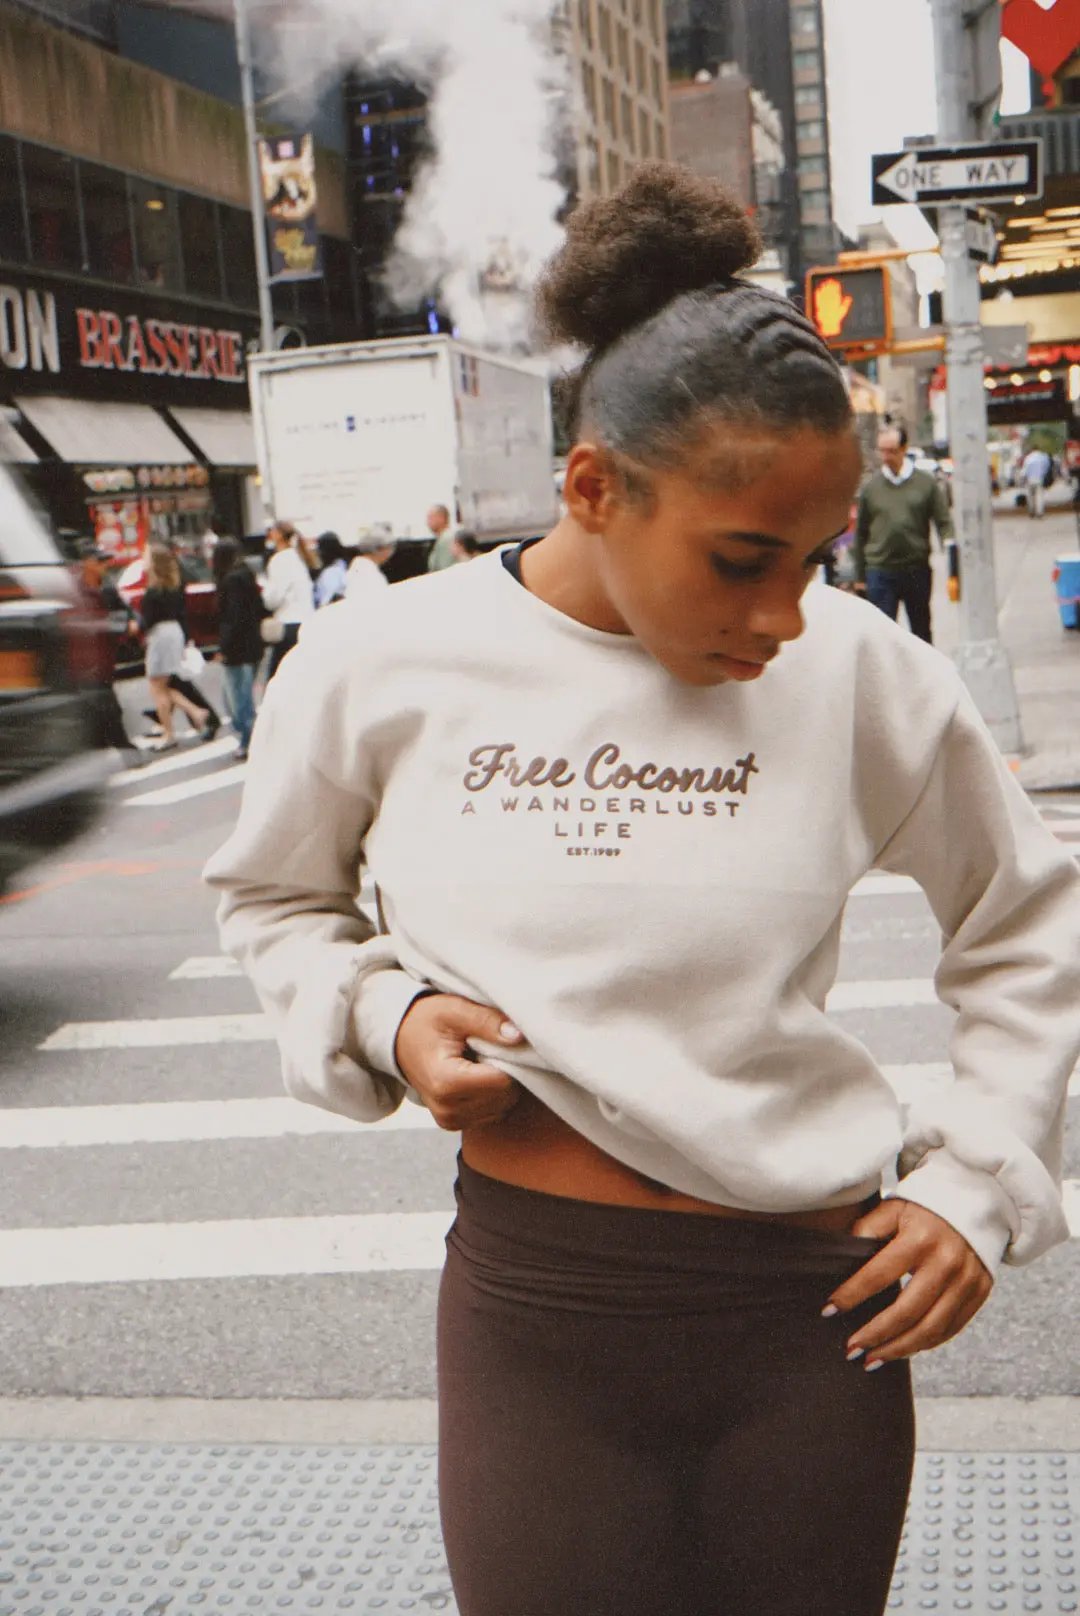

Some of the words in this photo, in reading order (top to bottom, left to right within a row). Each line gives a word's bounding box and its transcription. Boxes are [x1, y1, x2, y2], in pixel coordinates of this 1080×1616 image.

[895, 165, 942, 189] ONE
[966, 159, 1016, 183] WAY
[76, 307, 246, 383] BRASSERIE
[463, 743, 576, 791] Free
[584, 743, 759, 794] Coconut
[461, 800, 476, 815] A
[501, 796, 740, 817] WANDERLUST
[555, 822, 631, 838] LIFE
